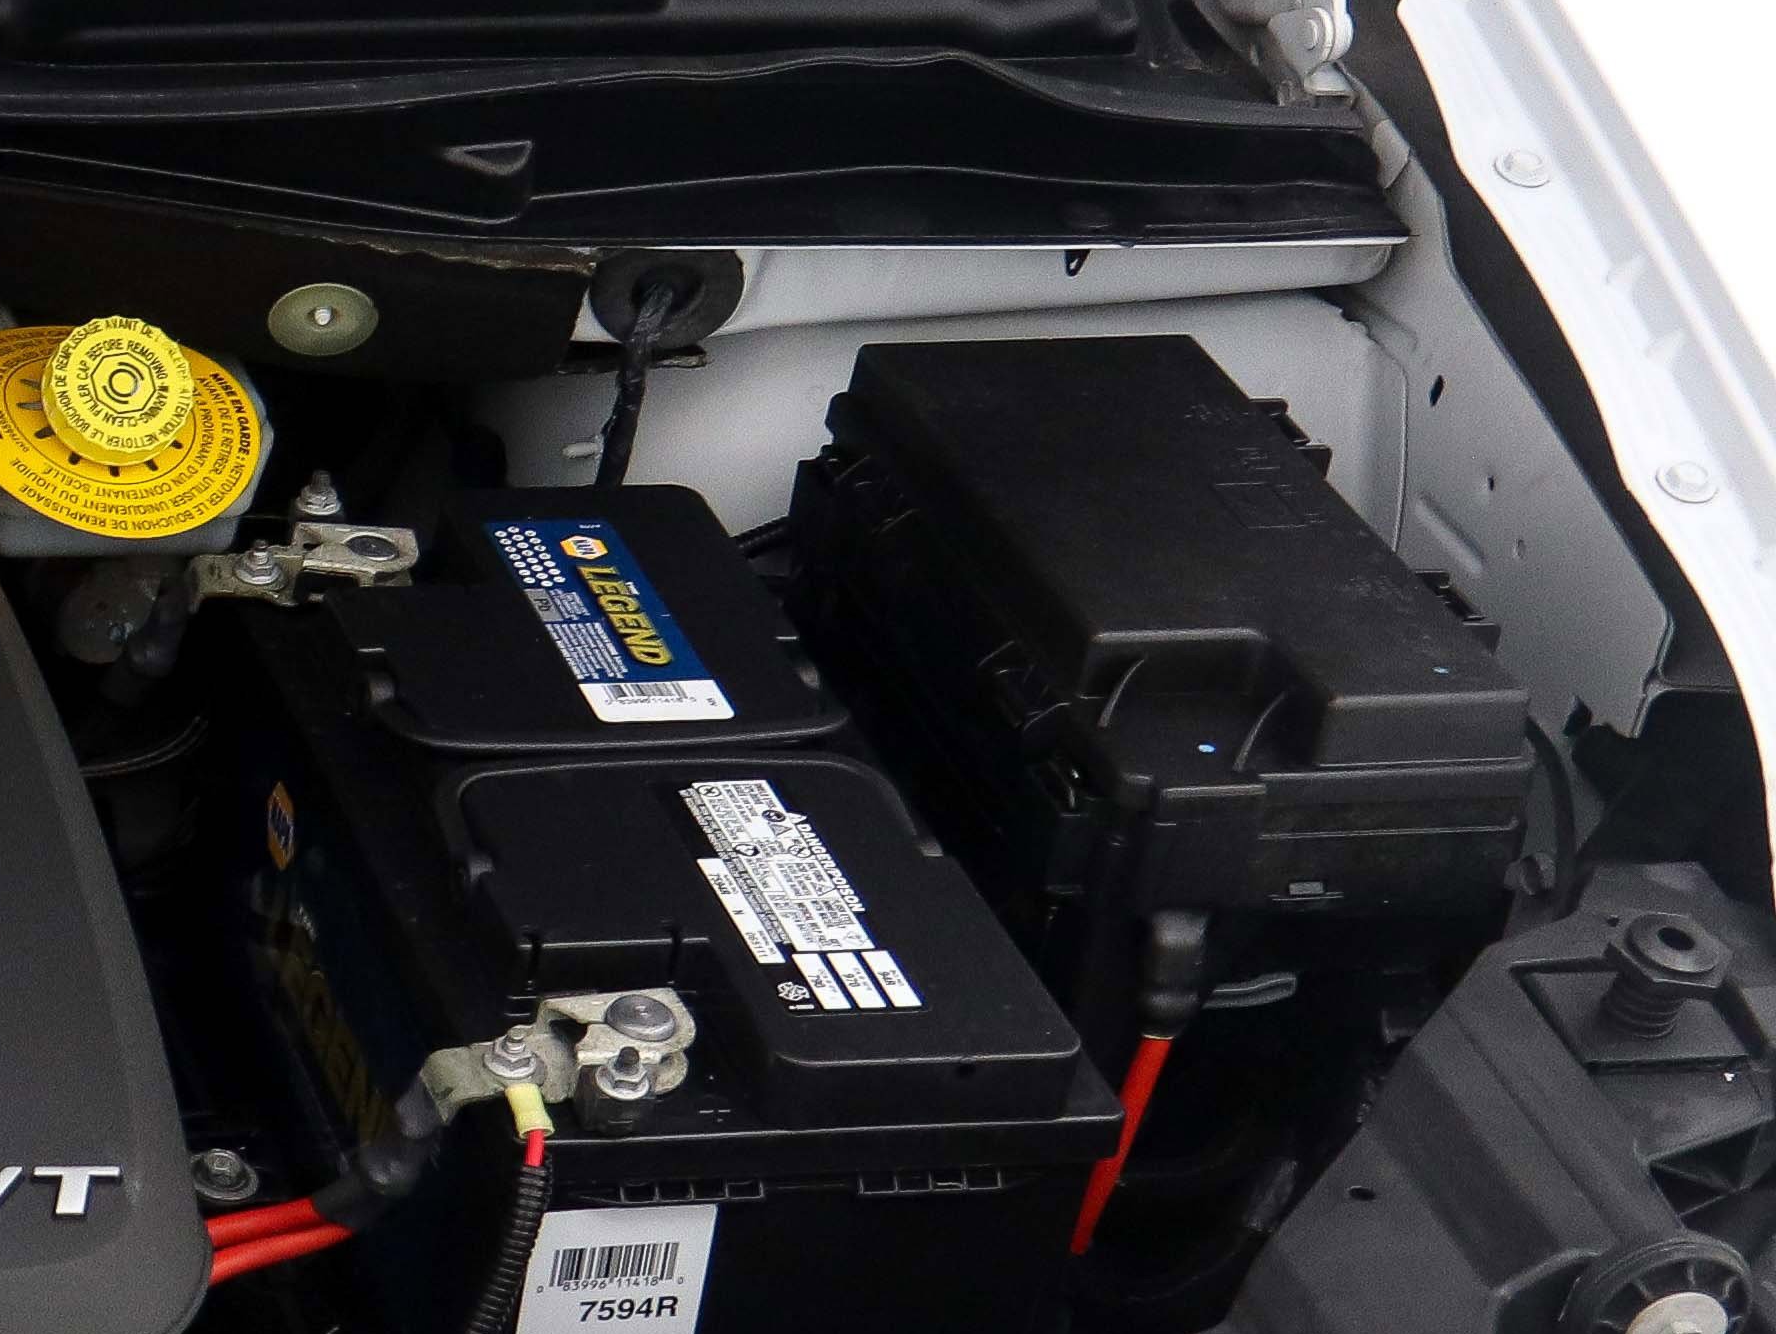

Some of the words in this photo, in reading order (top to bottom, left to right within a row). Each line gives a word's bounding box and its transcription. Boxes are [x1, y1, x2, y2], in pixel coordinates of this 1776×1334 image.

[105, 318, 138, 331] AVANT
[77, 358, 90, 381] CAP
[55, 374, 68, 387] DE
[210, 372, 237, 397] MISE
[56, 389, 93, 433] BOUCHON
[78, 385, 107, 418] FILLER
[232, 398, 246, 414] EN
[91, 428, 104, 441] LE
[220, 420, 234, 435] LE
[95, 483, 173, 501] CONTENANT
[209, 461, 246, 504] NETTOYER
[18, 482, 107, 528] REMPLISSAGE
[59, 490, 80, 504] DU
[83, 497, 172, 516] UNIQUEMENT
[197, 499, 210, 512] LE
[112, 519, 129, 531] DE
[130, 508, 195, 531] BOUCHON
[533, 597, 553, 612] Pb
[577, 566, 673, 665] LEGEND
[797, 823, 866, 912] DANGER/POISON
[580, 1296, 680, 1323] 7594R
